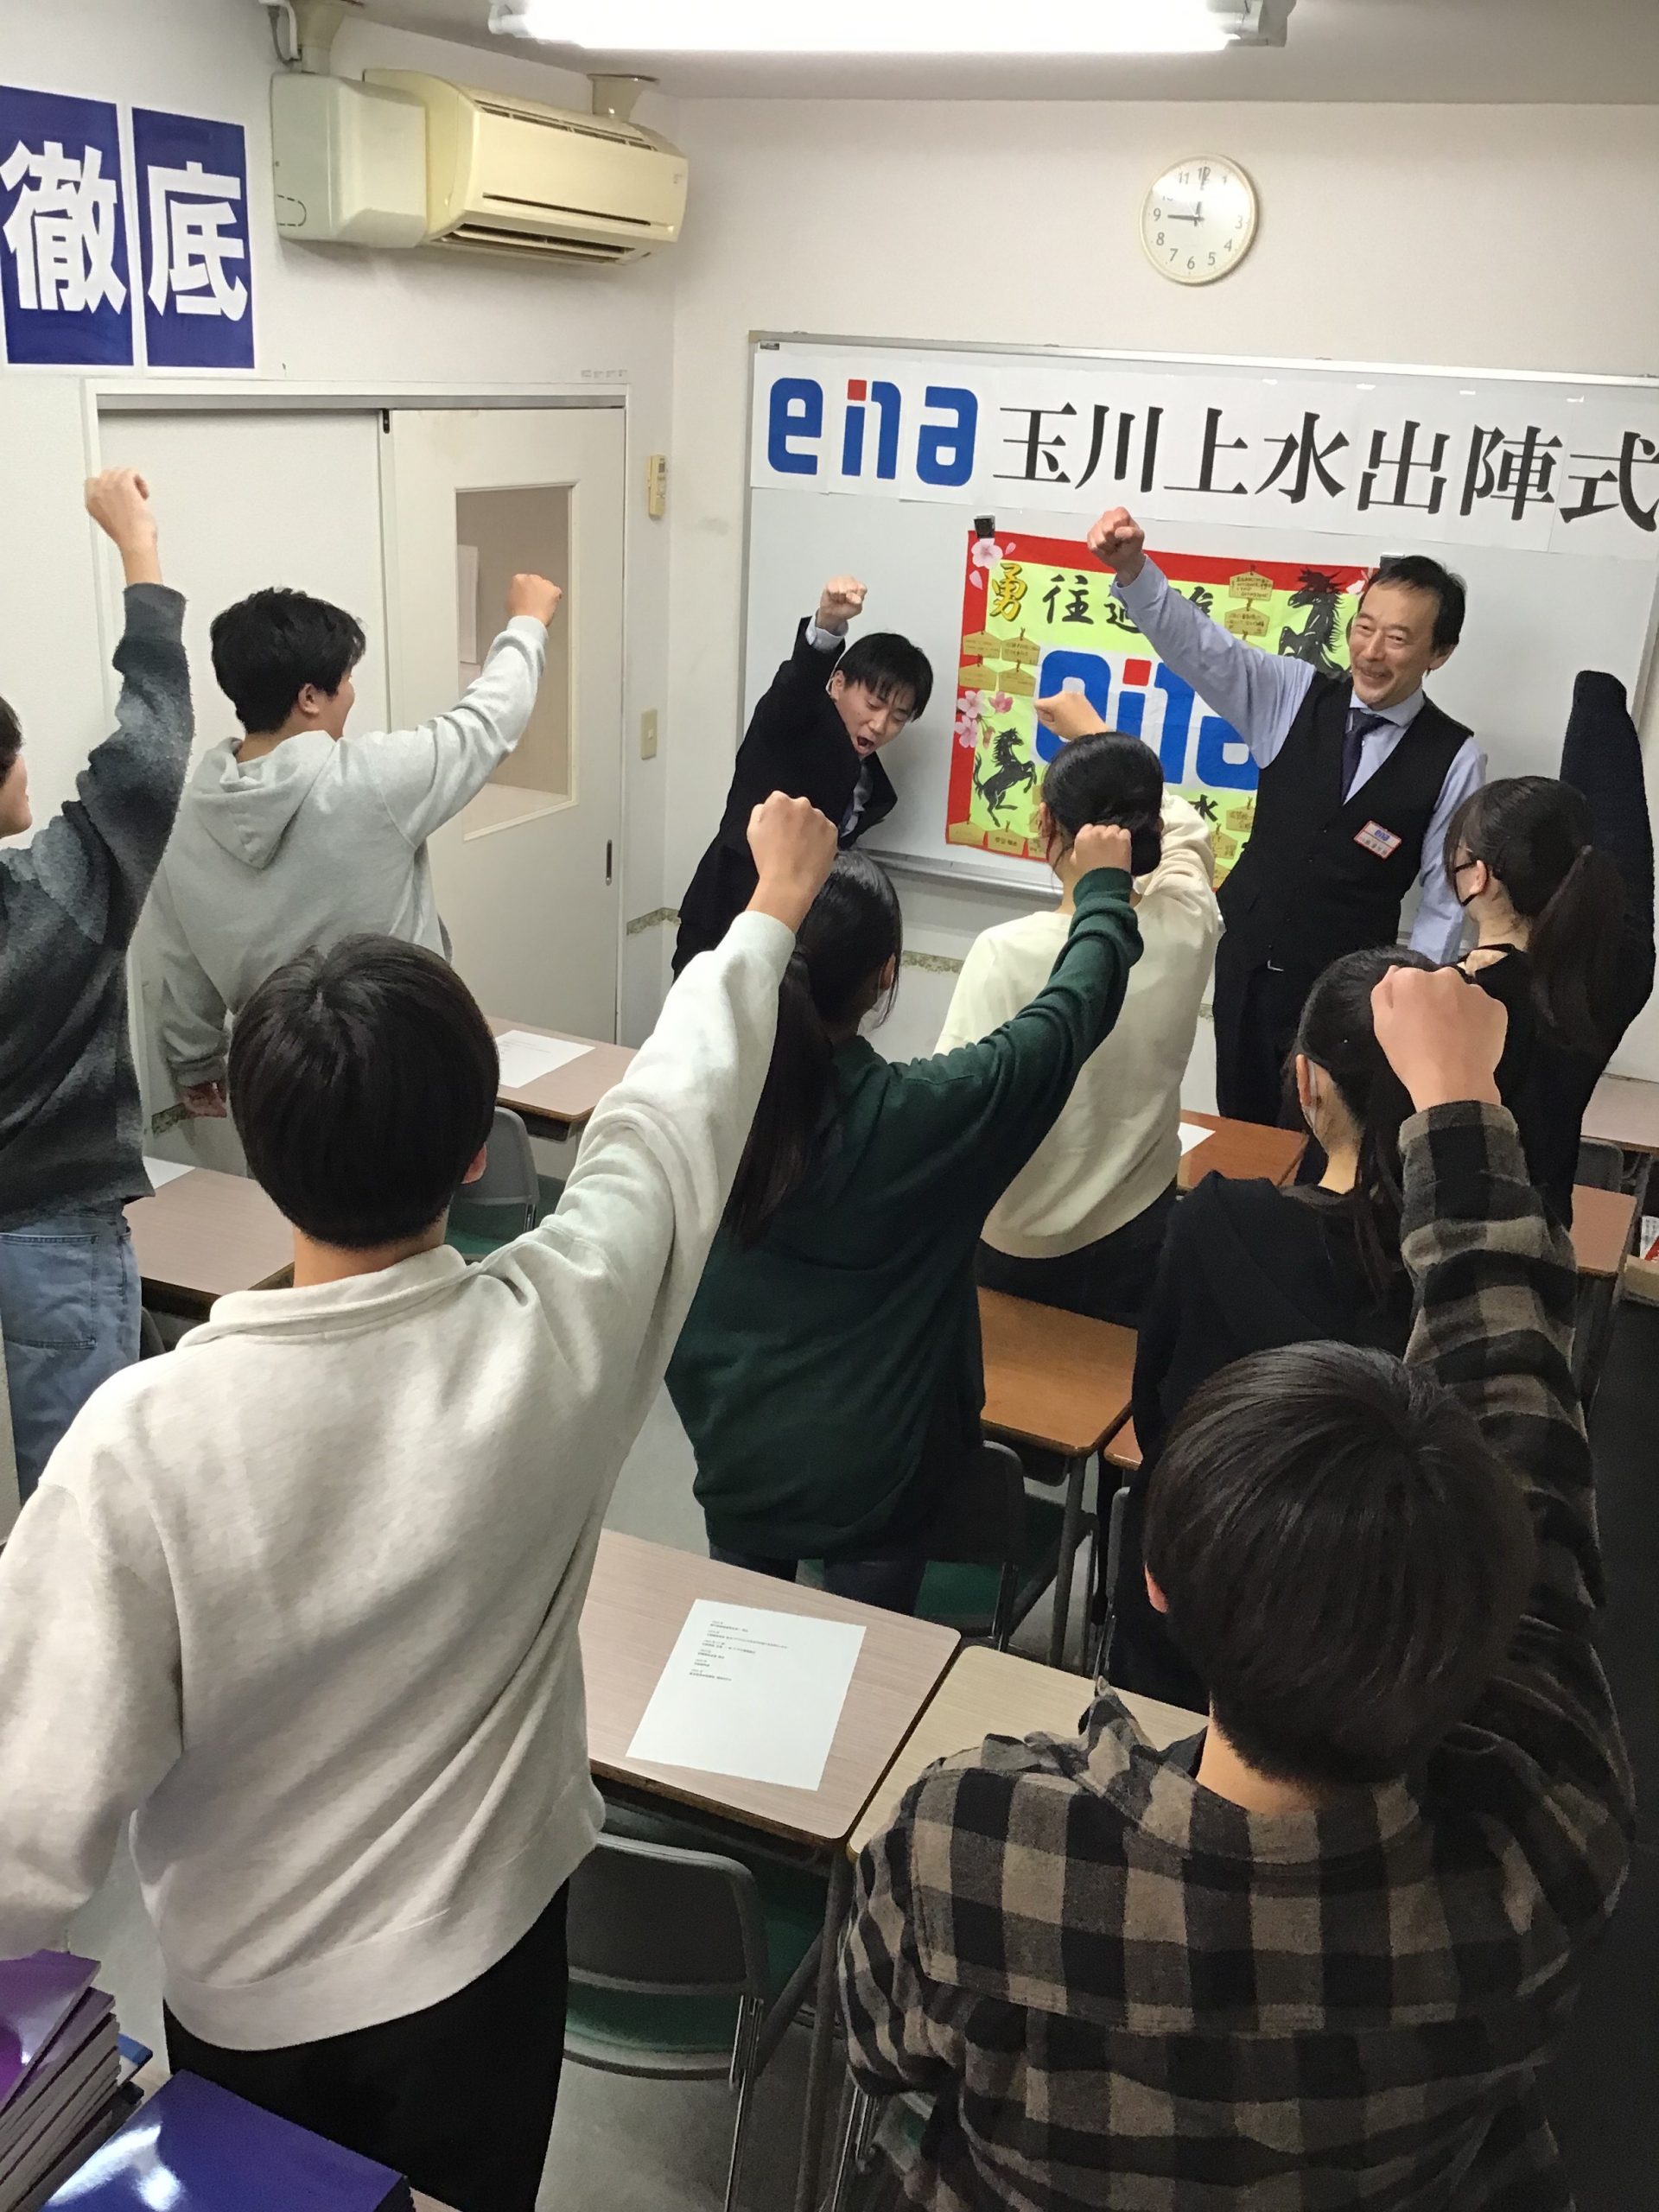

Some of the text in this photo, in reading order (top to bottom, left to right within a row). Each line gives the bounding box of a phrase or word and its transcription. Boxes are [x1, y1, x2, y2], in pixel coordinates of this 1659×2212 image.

[1153, 207, 1161, 221] 9
[1235, 215, 1243, 230] 3
[0, 140, 249, 321] 徹底
[1156, 232, 1166, 246] 8
[1224, 238, 1233, 252] 4
[1169, 248, 1179, 262] 7
[1208, 251, 1217, 266] 5
[1186, 256, 1195, 270] 6
[767, 377, 1659, 532] ena 玉川上水出陣式
